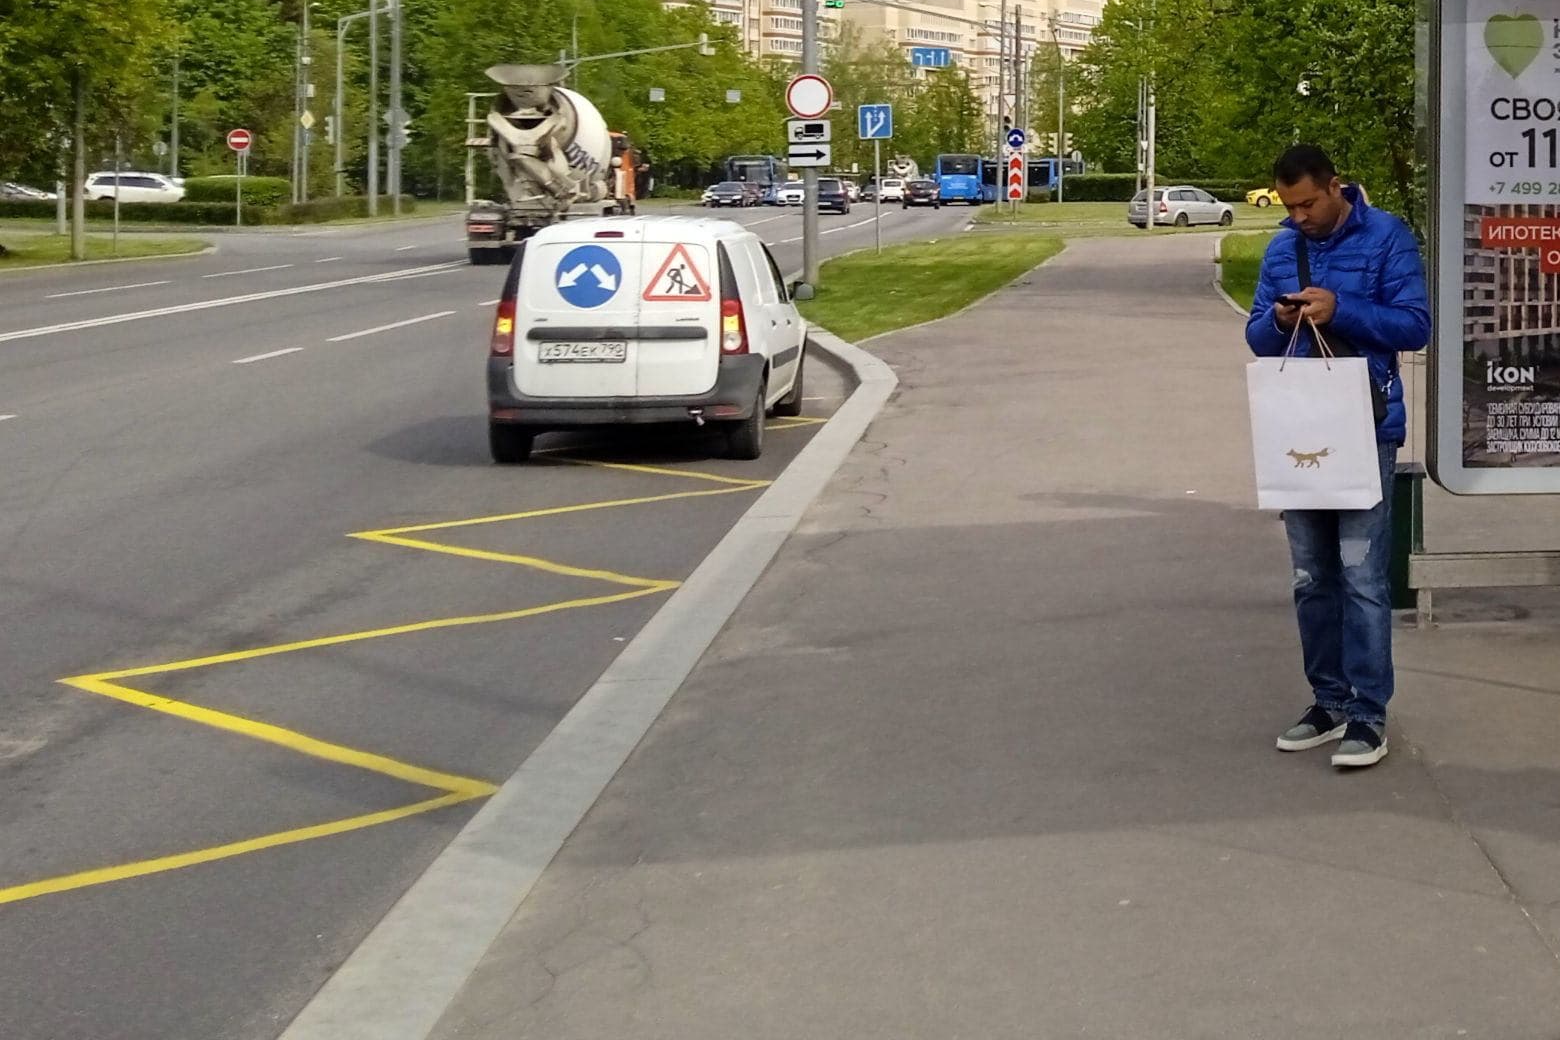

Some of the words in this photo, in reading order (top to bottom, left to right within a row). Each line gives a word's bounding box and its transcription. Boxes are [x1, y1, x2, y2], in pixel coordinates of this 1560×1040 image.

[1521, 128, 1558, 168] 11
[1489, 182, 1505, 195] +7
[1510, 181, 1542, 195] 499
